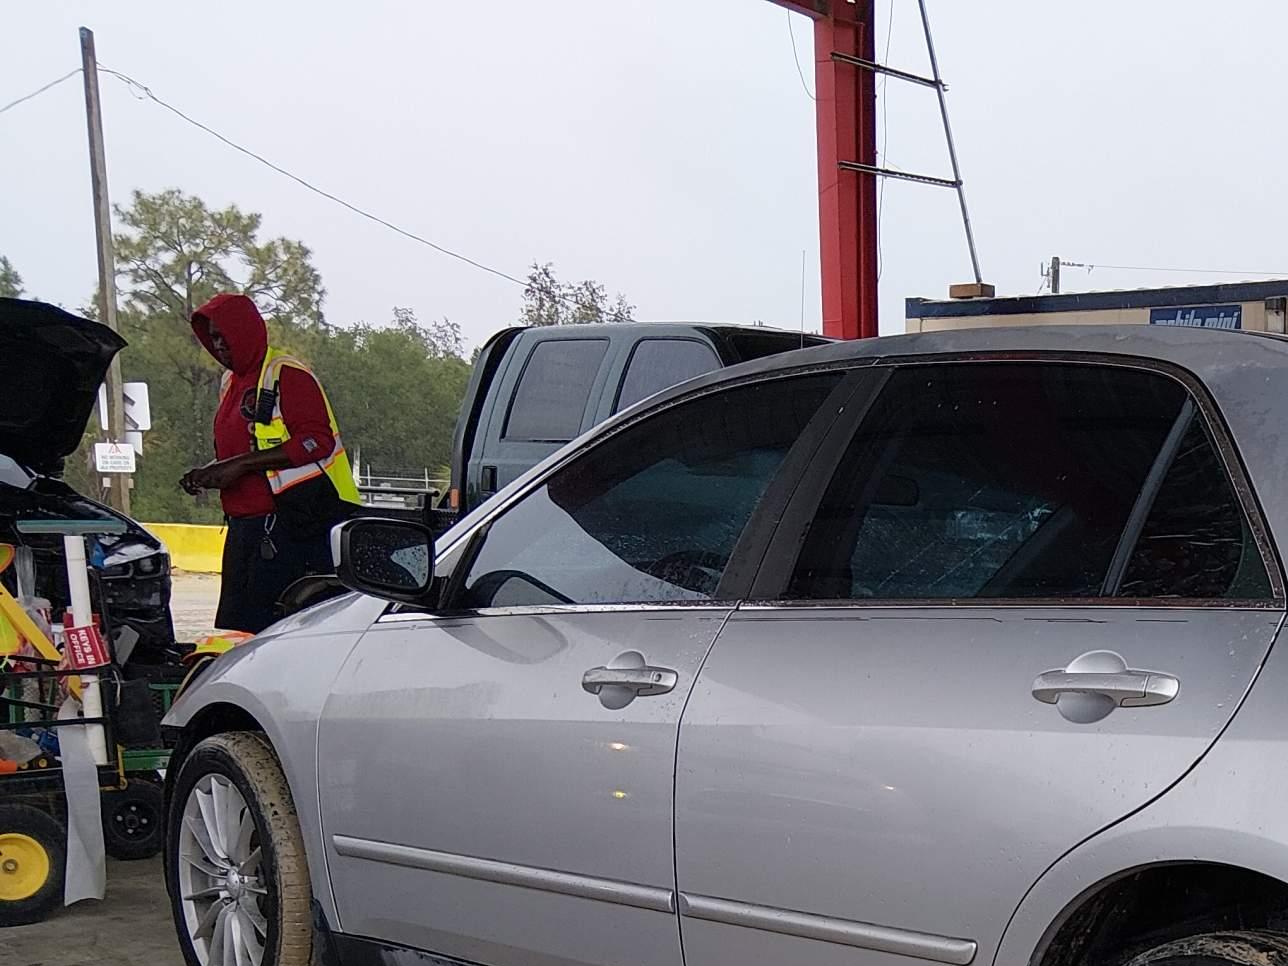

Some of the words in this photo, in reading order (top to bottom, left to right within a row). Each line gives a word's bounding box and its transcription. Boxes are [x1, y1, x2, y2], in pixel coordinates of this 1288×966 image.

[1204, 311, 1239, 329] mini
[70, 633, 86, 664] OFFICE
[78, 629, 92, 653] KEYS
[86, 655, 96, 664] IN
